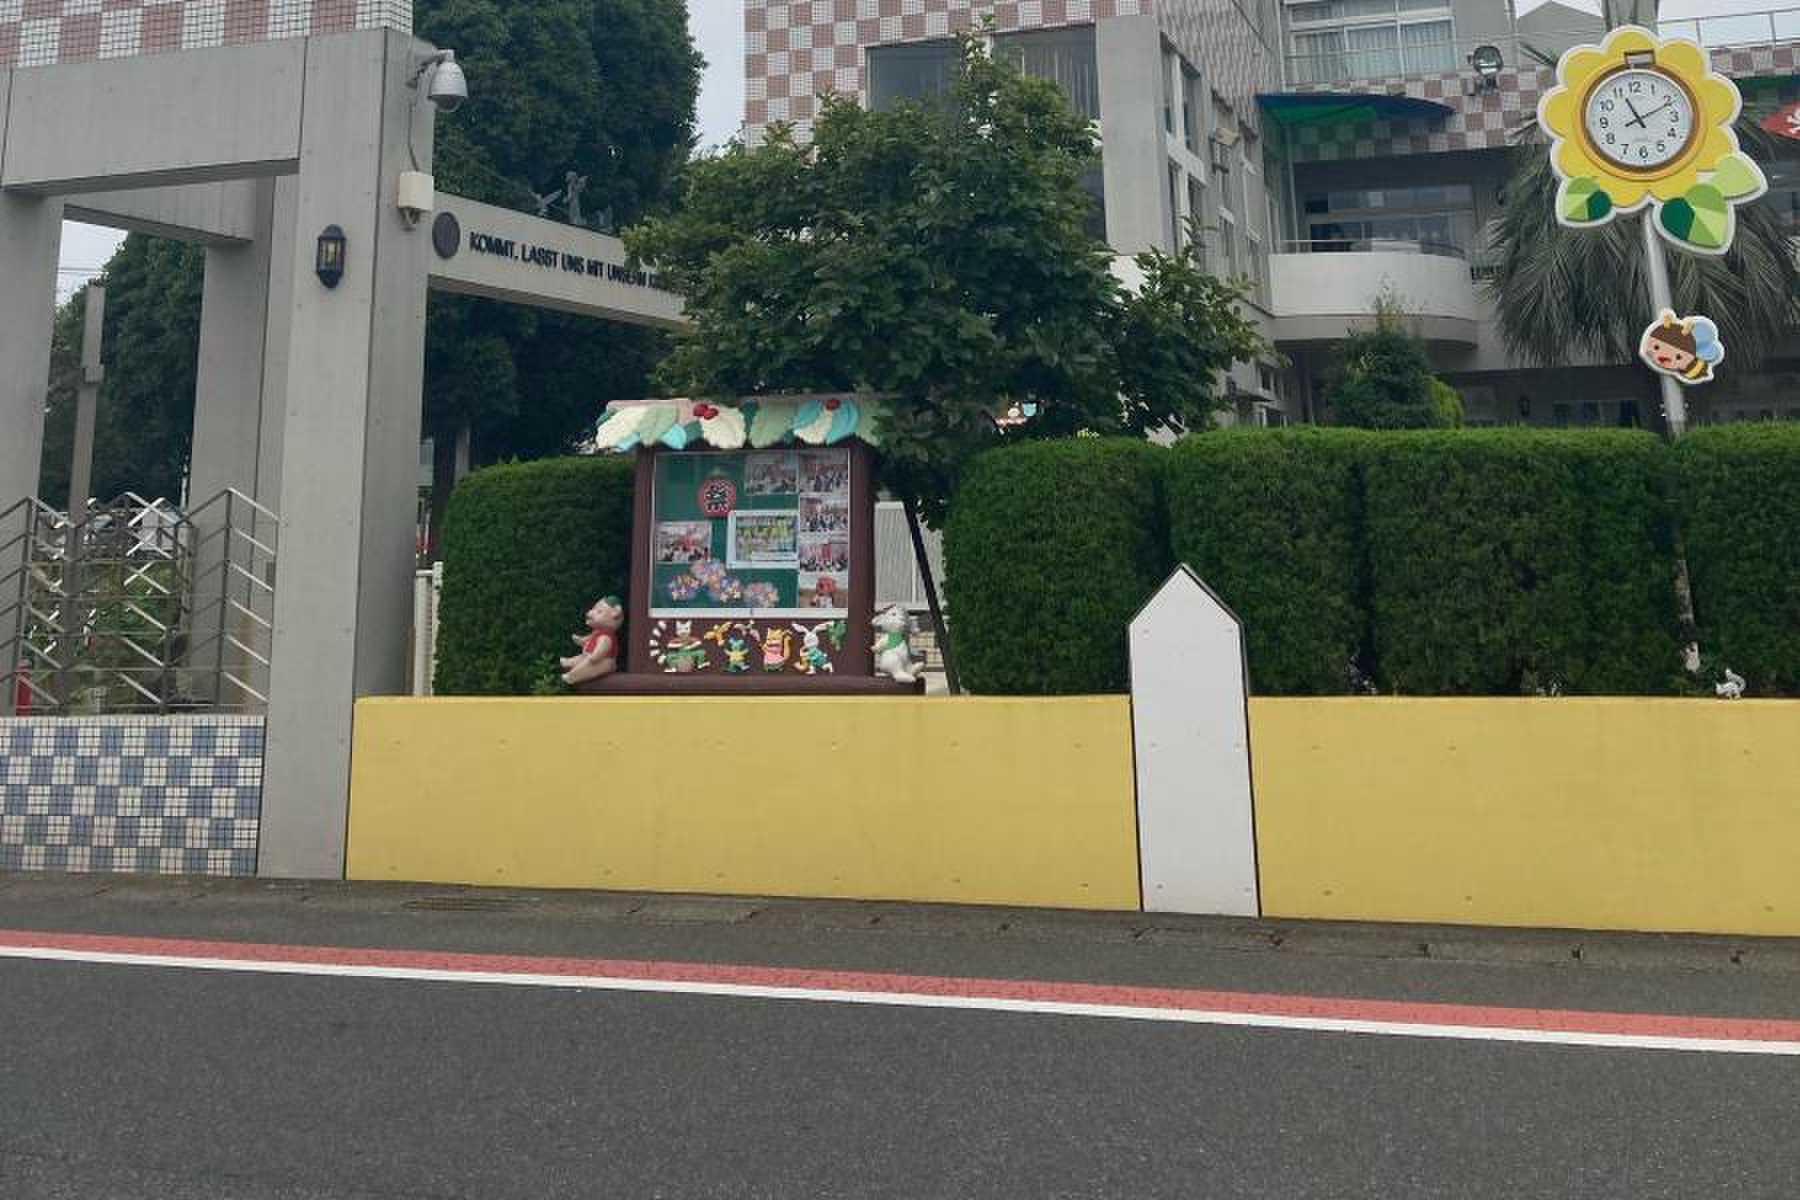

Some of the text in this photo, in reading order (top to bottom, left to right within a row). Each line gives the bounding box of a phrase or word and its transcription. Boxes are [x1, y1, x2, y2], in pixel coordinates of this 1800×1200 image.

[1614, 87, 1623, 98] 11
[1628, 81, 1641, 94] 12
[1600, 99, 1615, 112] 10
[1663, 95, 1671, 107] 2
[1599, 116, 1609, 128] 9
[1670, 111, 1679, 123] 3
[1606, 132, 1615, 145] 8
[1667, 127, 1676, 138] 4
[1620, 143, 1629, 155] 7
[1639, 146, 1649, 158] 6
[1656, 140, 1666, 153] 5
[561, 253, 585, 276] UNS
